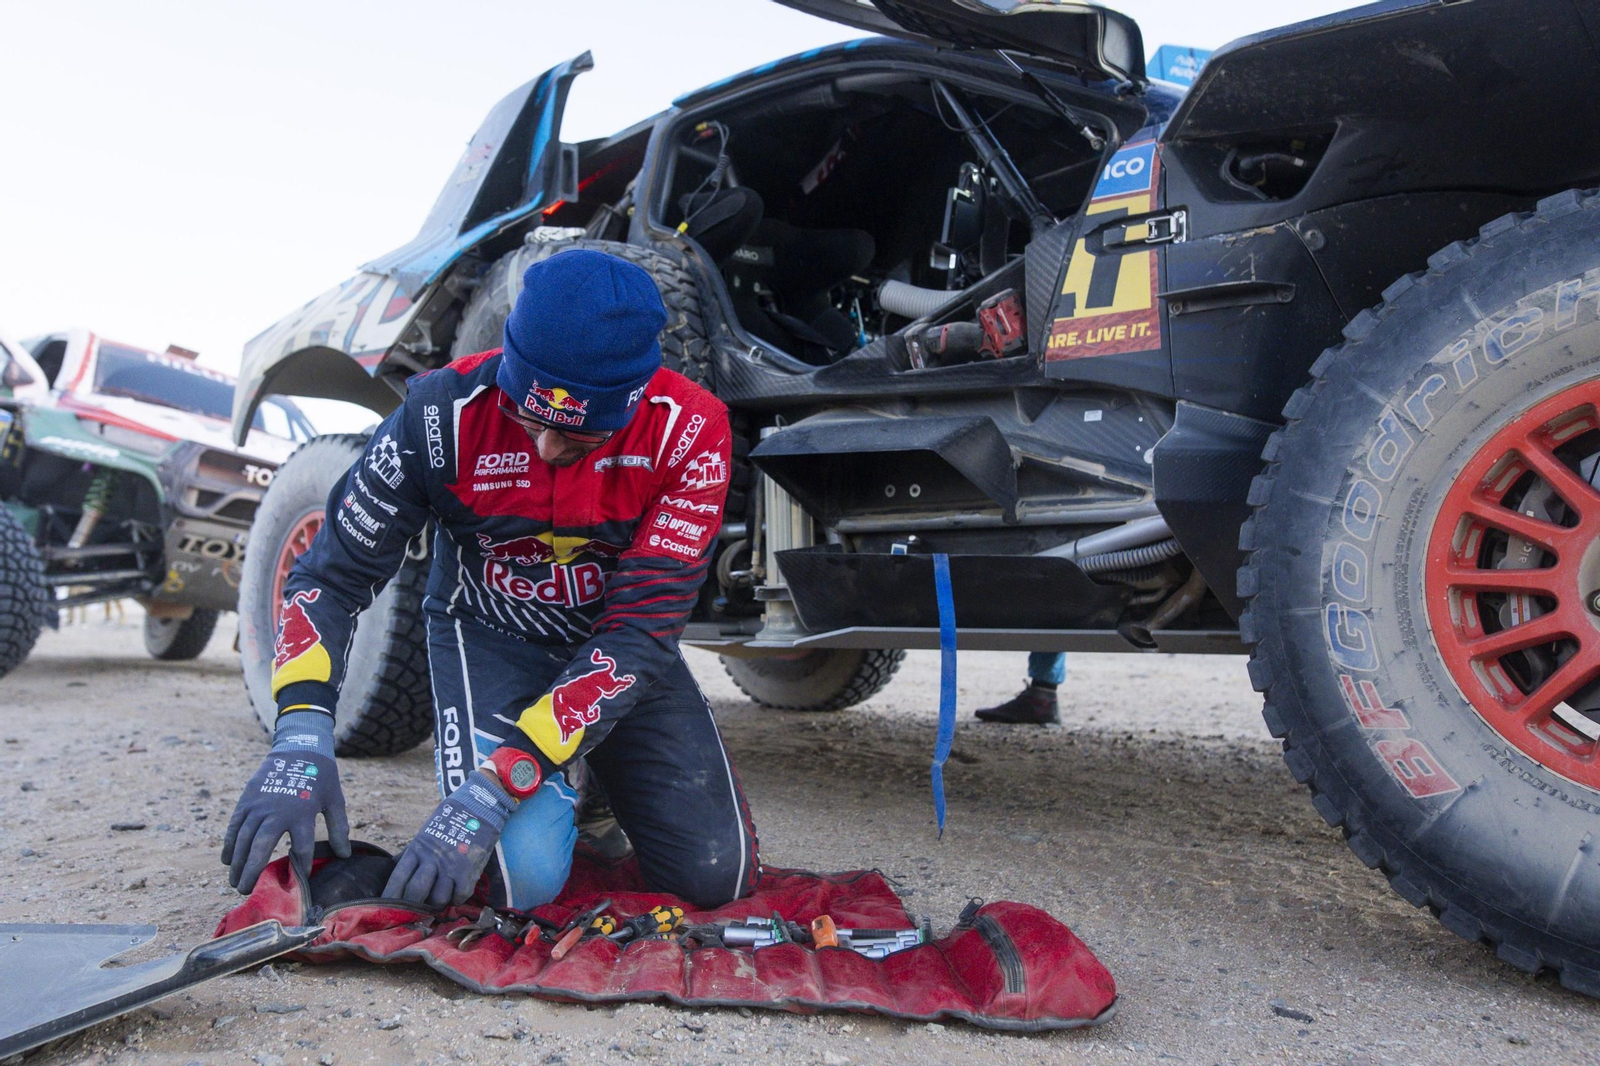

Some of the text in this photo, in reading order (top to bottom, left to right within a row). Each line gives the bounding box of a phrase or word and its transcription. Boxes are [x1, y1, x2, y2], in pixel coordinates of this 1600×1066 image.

[1086, 324, 1128, 344] LIVE
[1129, 321, 1152, 339] IT.
[524, 394, 585, 427] Red Bull
[424, 404, 446, 469] sparco
[668, 413, 707, 469] sparco
[474, 465, 530, 477] PERFORMANCE
[476, 452, 530, 469] FORD
[472, 479, 531, 492] SAMSUNG SSD
[341, 517, 377, 549] Castrol
[660, 537, 702, 558] Castrol
[483, 558, 575, 609] Red
[443, 706, 467, 794] FORD
